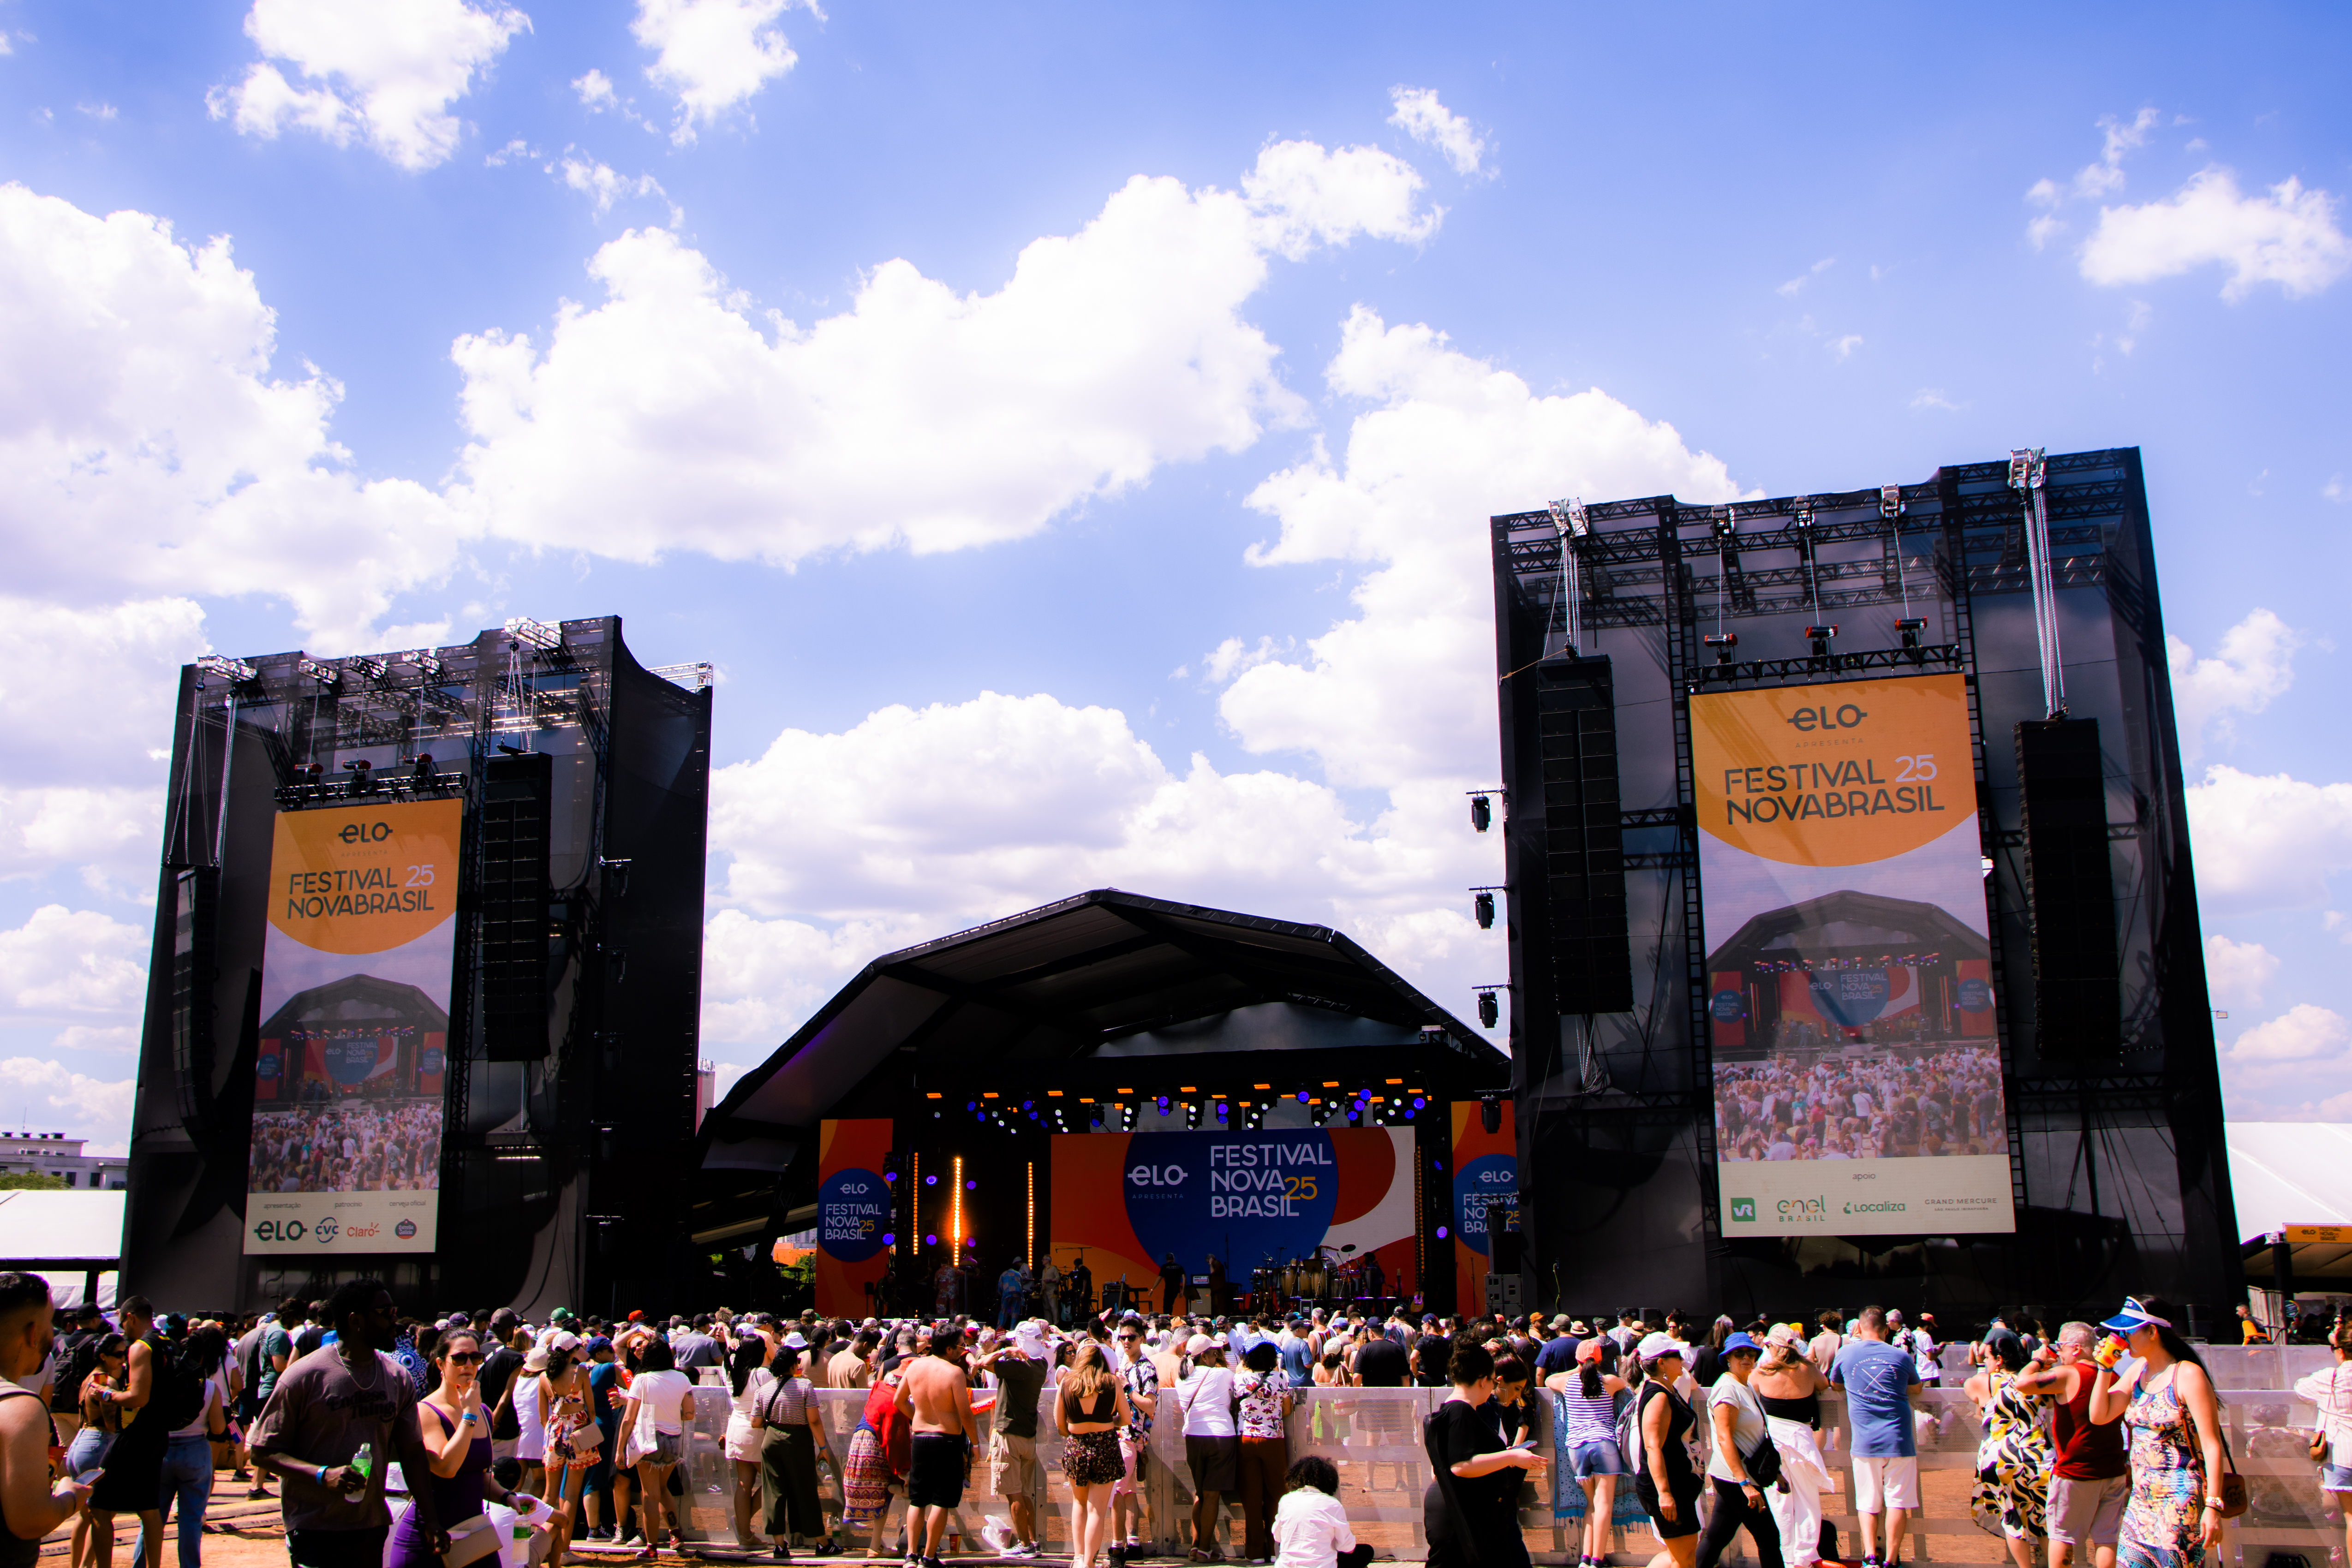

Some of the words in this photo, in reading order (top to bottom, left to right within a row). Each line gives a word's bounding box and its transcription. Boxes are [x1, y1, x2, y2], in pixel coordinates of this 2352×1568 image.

[1795, 738, 1864, 748] APRESENTA
[1725, 759, 1885, 795] FESTIVAL
[1895, 754, 1937, 783] 25
[1727, 785, 1945, 825] NOVABRASIL
[289, 867, 398, 894] FESTIVAL
[405, 864, 435, 887] 25
[287, 890, 434, 919] NOVABRASIL
[1840, 973, 1887, 983] FESTIVAL
[1841, 983, 1870, 991] NOVA
[1842, 992, 1876, 1000] BRASIL
[1210, 1143, 1332, 1167] FESTIVAL
[1211, 1169, 1285, 1192] NOVA
[1284, 1176, 1318, 1200] 25
[1852, 1172, 1876, 1182] apoio
[826, 1204, 882, 1215] FESTIVAL
[1212, 1195, 1300, 1217] BRASIL
[1777, 1195, 1826, 1213] enel
[1854, 1201, 1906, 1212] Localiza
[347, 1226, 375, 1237] Claro
[825, 1216, 860, 1227] NOVA
[859, 1220, 874, 1232] 25
[825, 1229, 866, 1240] BRASIL
[326, 1390, 387, 1411] Endless
